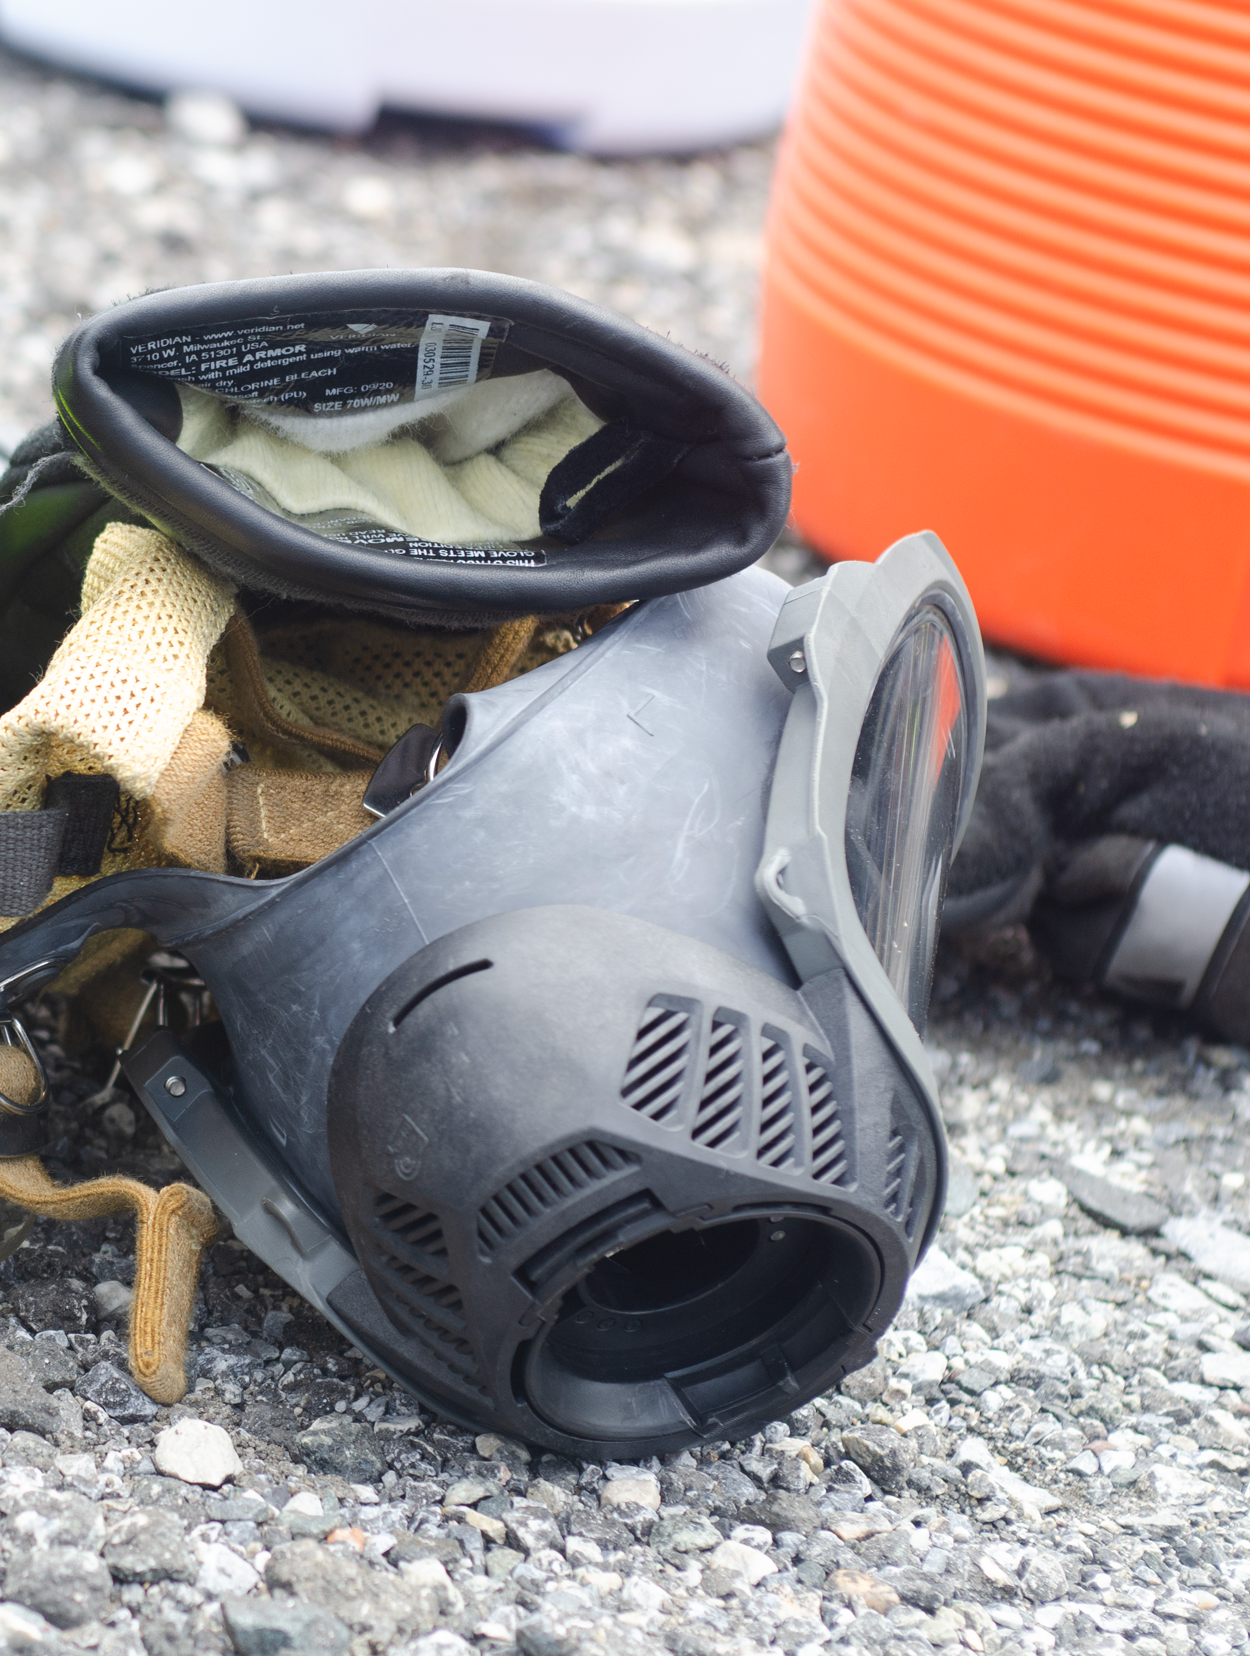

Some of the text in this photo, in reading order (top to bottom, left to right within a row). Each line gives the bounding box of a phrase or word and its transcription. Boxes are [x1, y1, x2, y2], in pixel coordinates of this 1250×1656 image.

[130, 335, 192, 354] VERIDIAN
[203, 322, 305, 340] www.veridian.net
[130, 352, 160, 363] 3710
[162, 347, 179, 359] W.
[183, 338, 244, 353] Milwaukee
[140, 344, 307, 377] DEL: FIRE ARMOR
[185, 354, 199, 364] IA
[201, 346, 237, 359] 51301
[241, 340, 268, 352] USA
[198, 370, 223, 381] with
[226, 363, 251, 377] mild
[253, 353, 307, 370] detergent
[310, 348, 342, 360] using
[344, 344, 377, 354] warm
[214, 367, 337, 394] CHLORINE BLEACH
[325, 381, 394, 397] MFG: 09/20
[280, 391, 307, 401] (PU)
[313, 392, 400, 413] SIZE 70W/MW
[409, 548, 437, 556] THE
[439, 549, 486, 558] MEETS
[490, 548, 535, 558] GLOVE
